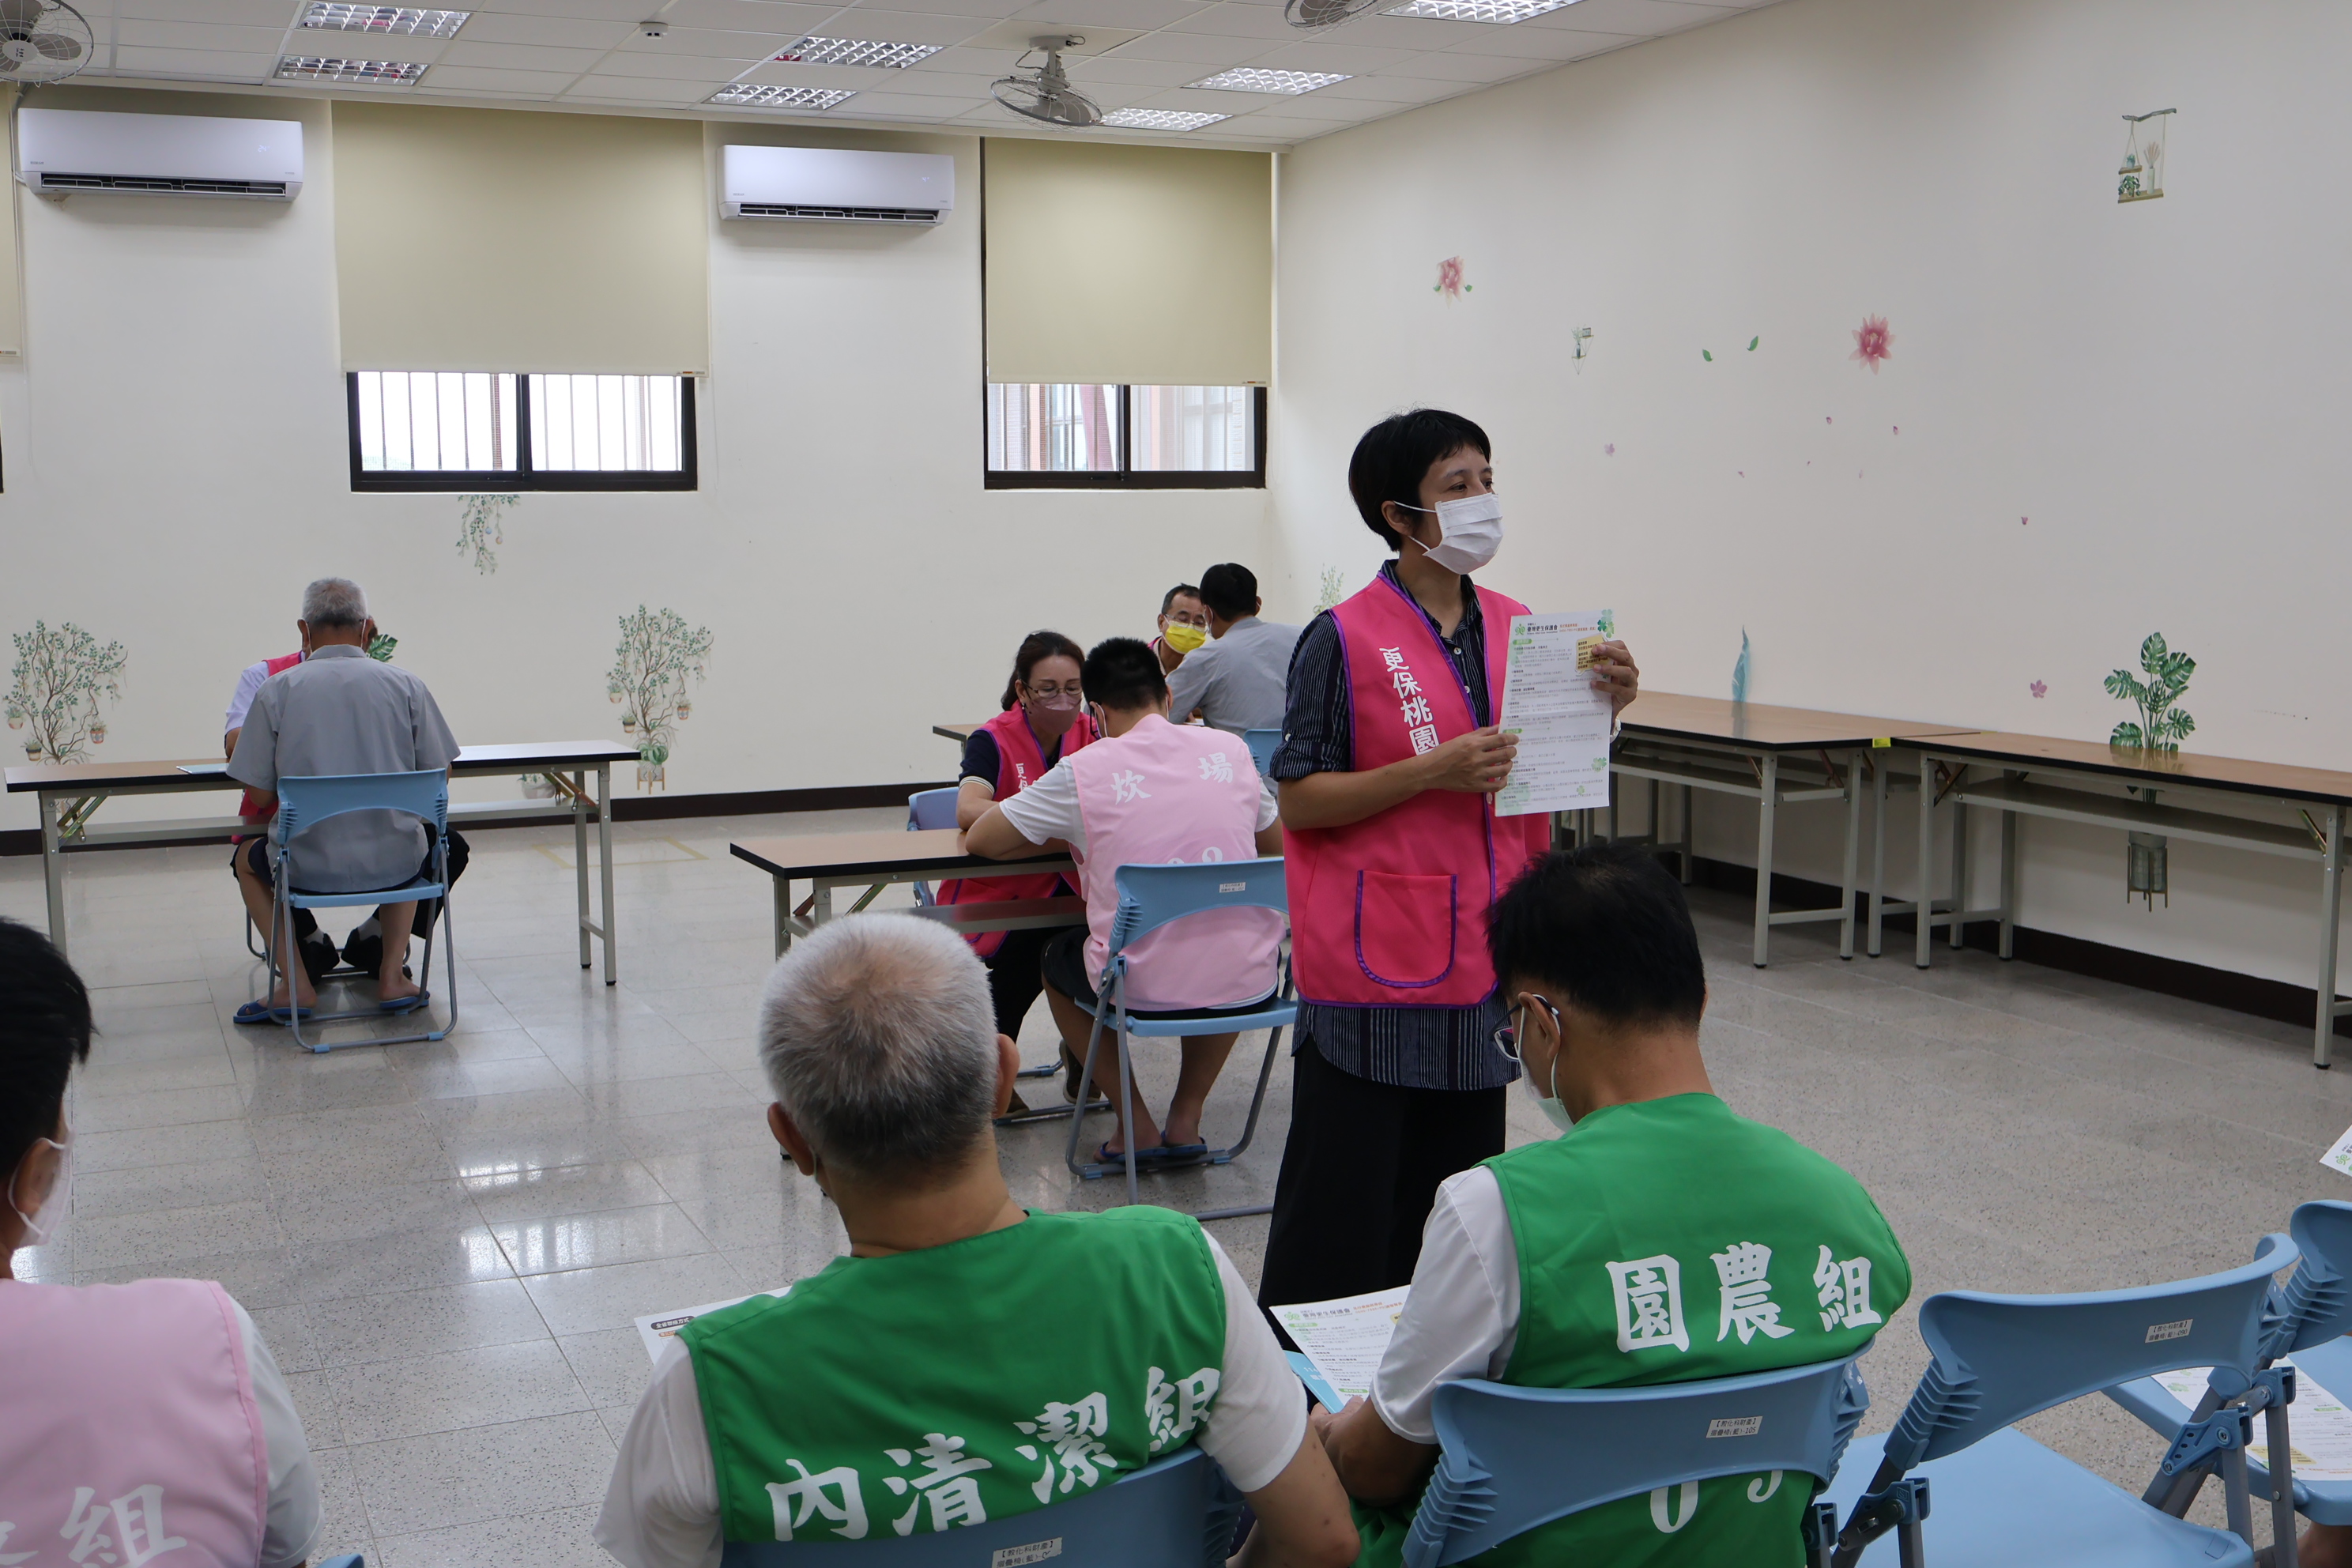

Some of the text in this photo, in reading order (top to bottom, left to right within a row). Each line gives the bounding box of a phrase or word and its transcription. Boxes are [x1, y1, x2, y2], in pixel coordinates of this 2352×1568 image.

[1378, 646, 1440, 756] 更保桃園
[1605, 1241, 1882, 1353] 園農組
[764, 1366, 1221, 1542] 內清潔組
[0, 1484, 187, 1568] 組
